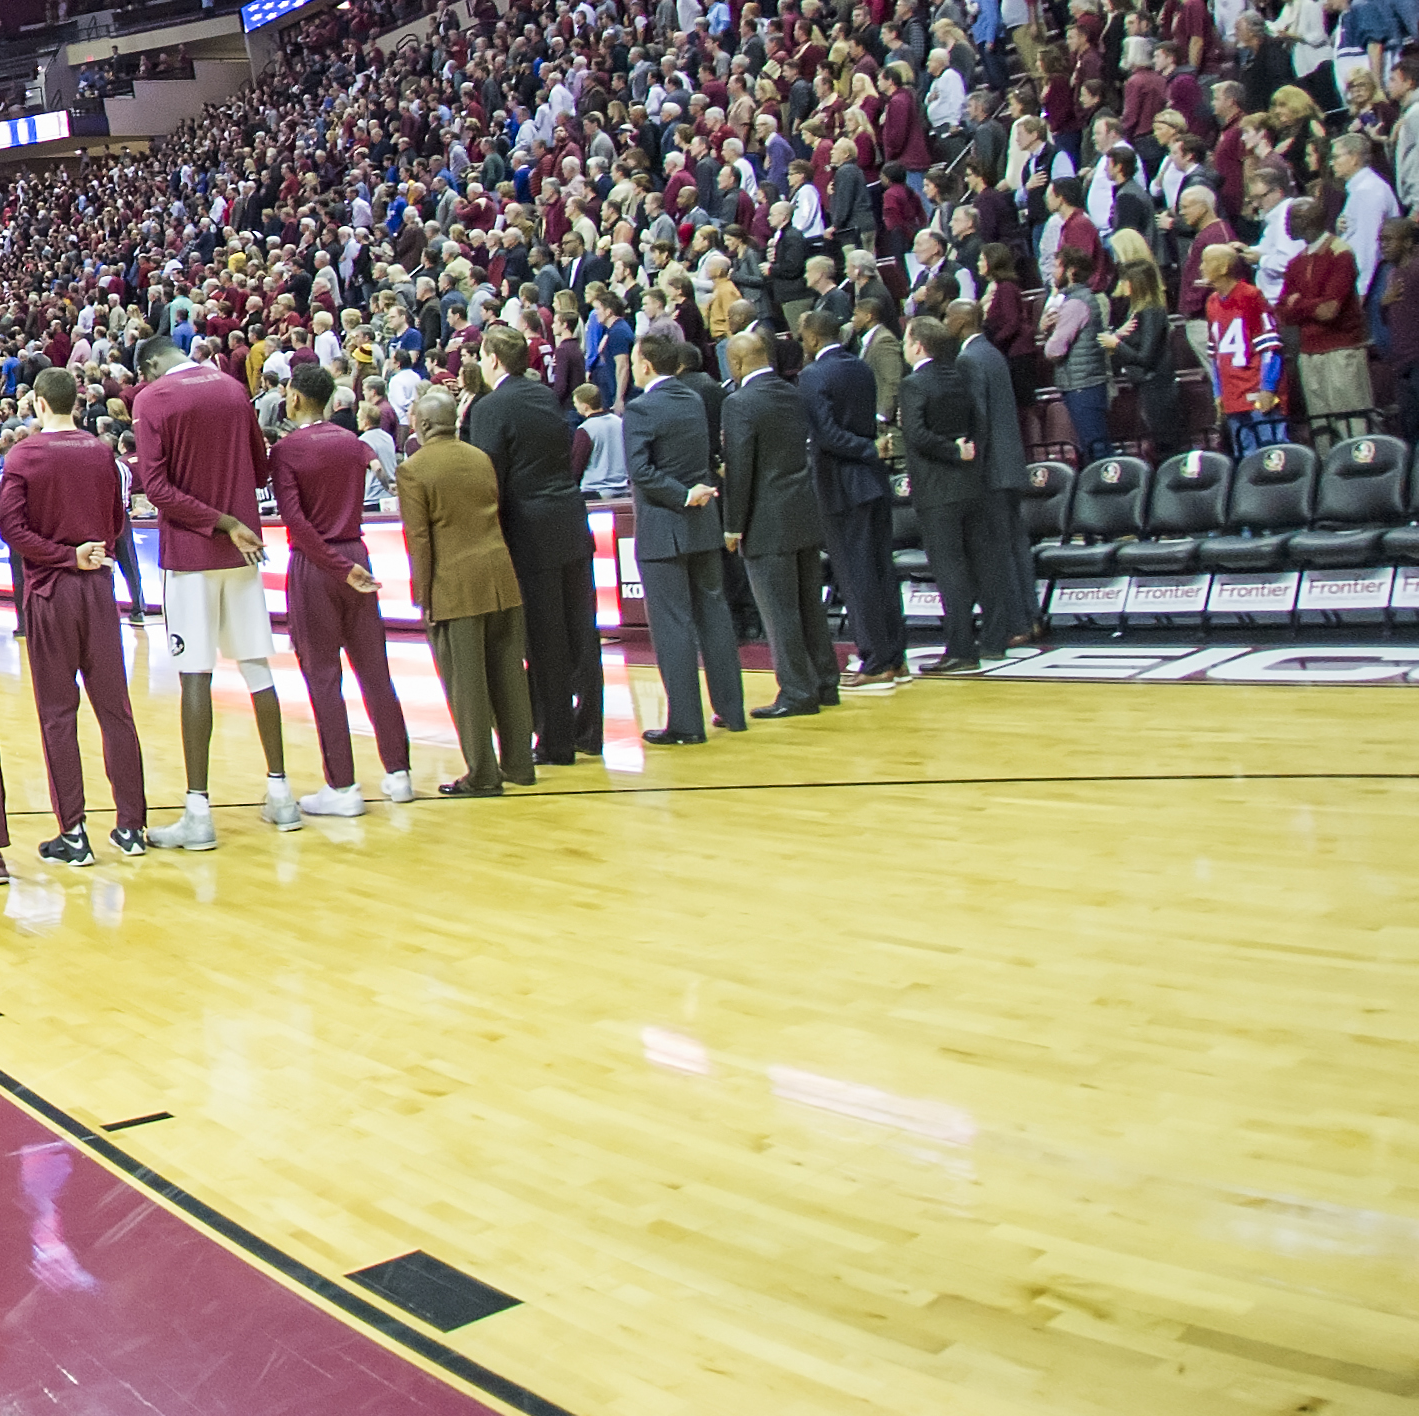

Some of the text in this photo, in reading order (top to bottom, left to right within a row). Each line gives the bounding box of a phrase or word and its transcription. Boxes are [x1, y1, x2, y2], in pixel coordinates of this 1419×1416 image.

[1058, 587, 1122, 601] Frontier
[1134, 584, 1203, 600] Frontier
[1218, 582, 1292, 598] Frontier
[1308, 578, 1386, 596] Frontier
